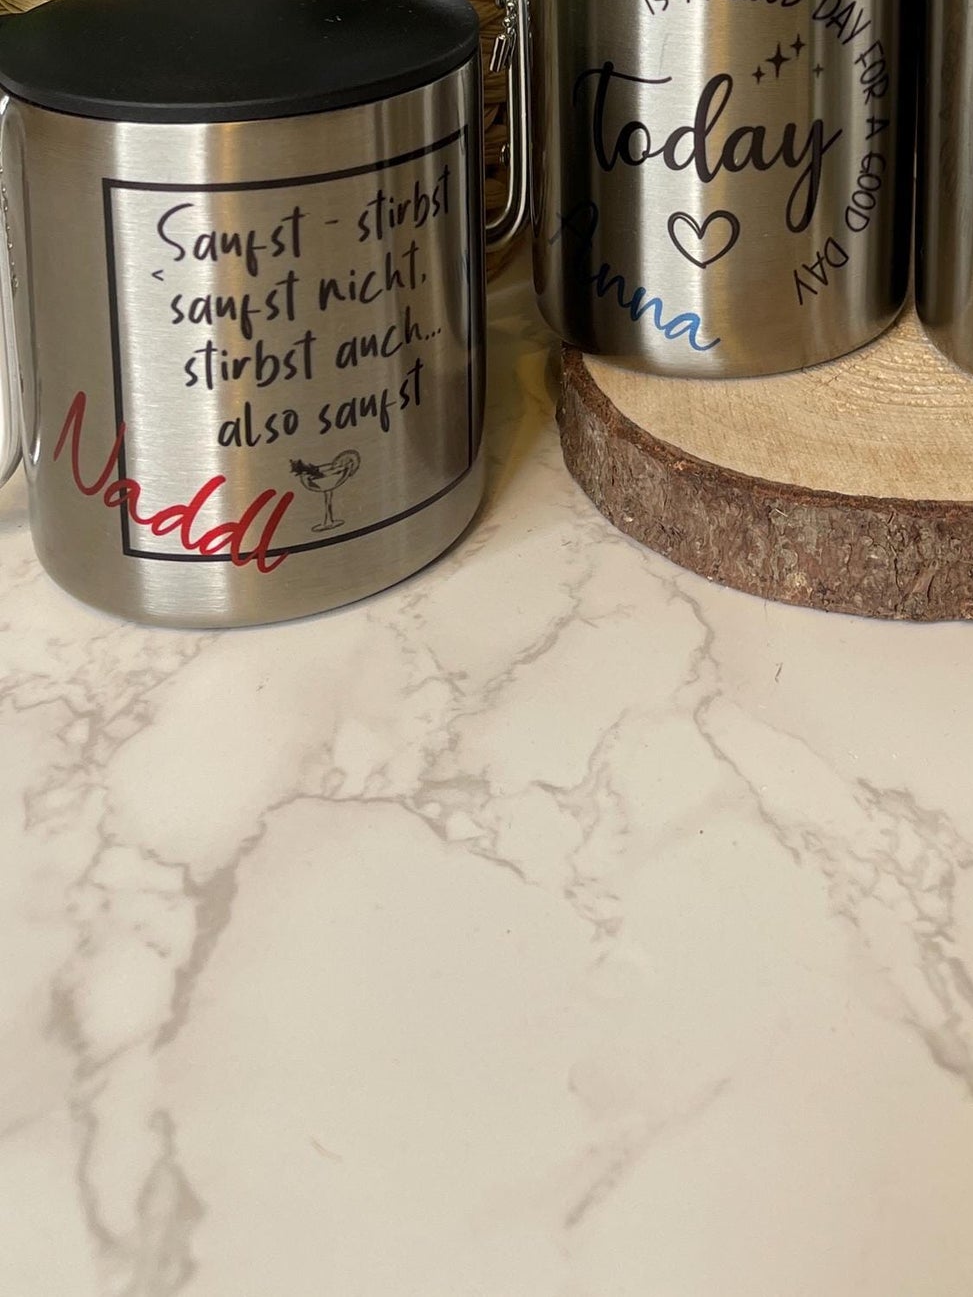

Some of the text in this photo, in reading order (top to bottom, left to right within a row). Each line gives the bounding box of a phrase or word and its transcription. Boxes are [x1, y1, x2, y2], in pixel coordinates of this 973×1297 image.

[854, 39, 889, 105] FOR
[865, 115, 890, 141] A
[156, 202, 311, 277] Saufst
[357, 164, 450, 243] stirbst
[845, 151, 886, 233] GOOD
[170, 270, 300, 340] saufst
[548, 200, 722, 352] Anna
[793, 236, 850, 305] DAY
[184, 340, 317, 390] stirbst
[217, 357, 424, 448] also saufst
